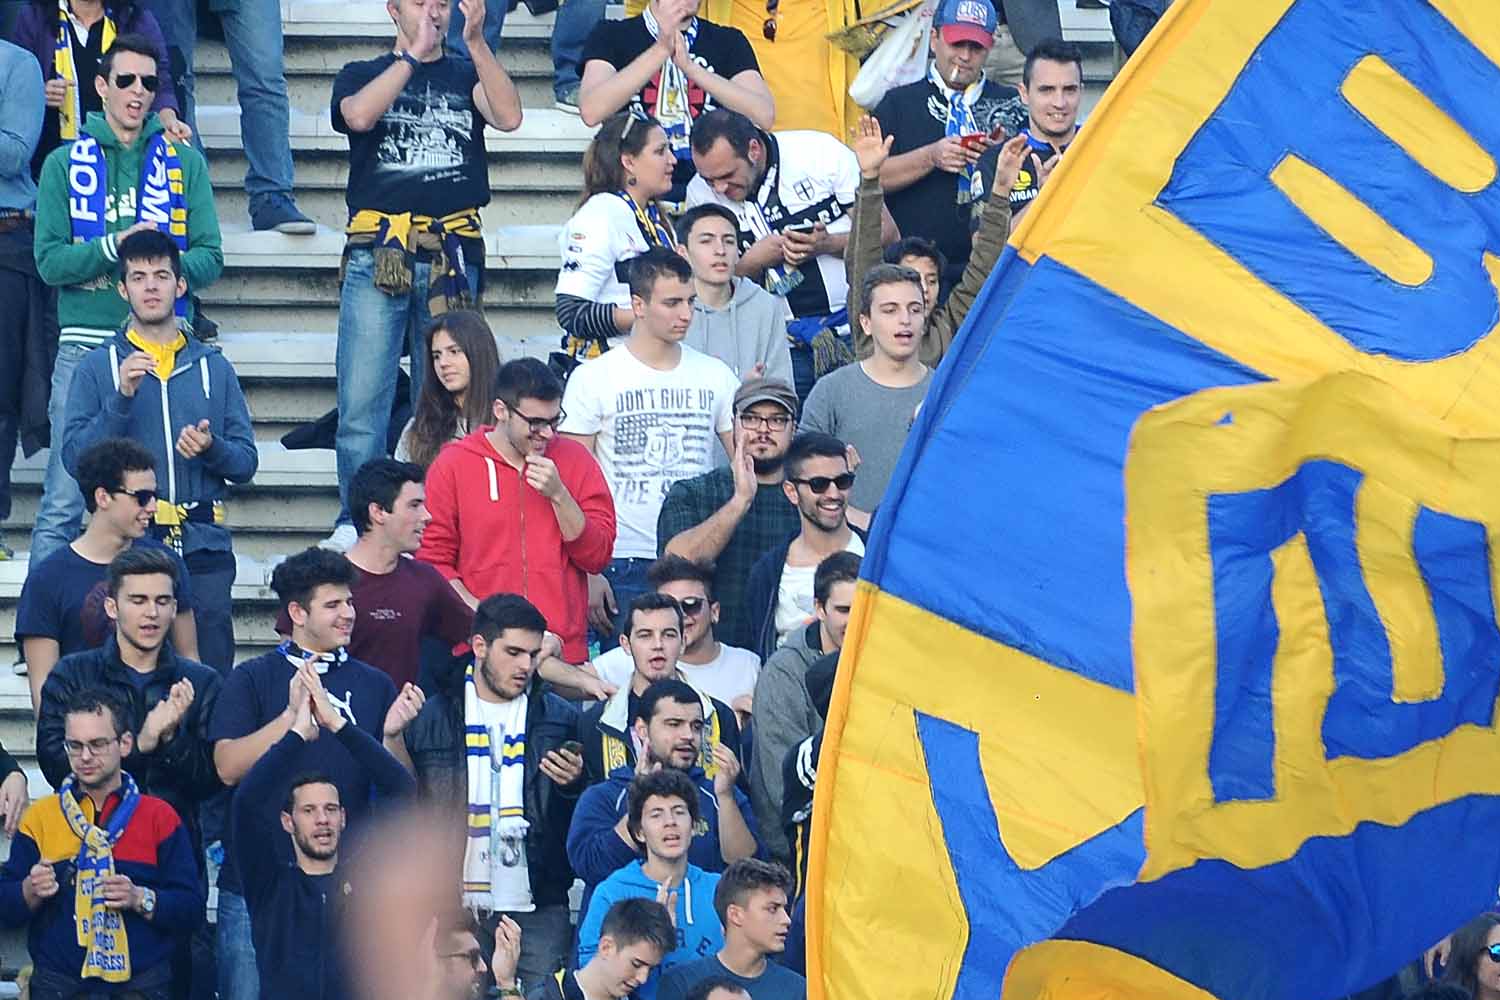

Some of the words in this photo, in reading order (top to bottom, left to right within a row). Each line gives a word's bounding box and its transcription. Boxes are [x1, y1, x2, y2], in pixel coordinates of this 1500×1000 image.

[70, 137, 98, 222] FOR
[616, 388, 656, 413] DON'T
[661, 388, 695, 410] GIVE
[699, 388, 715, 412] UP
